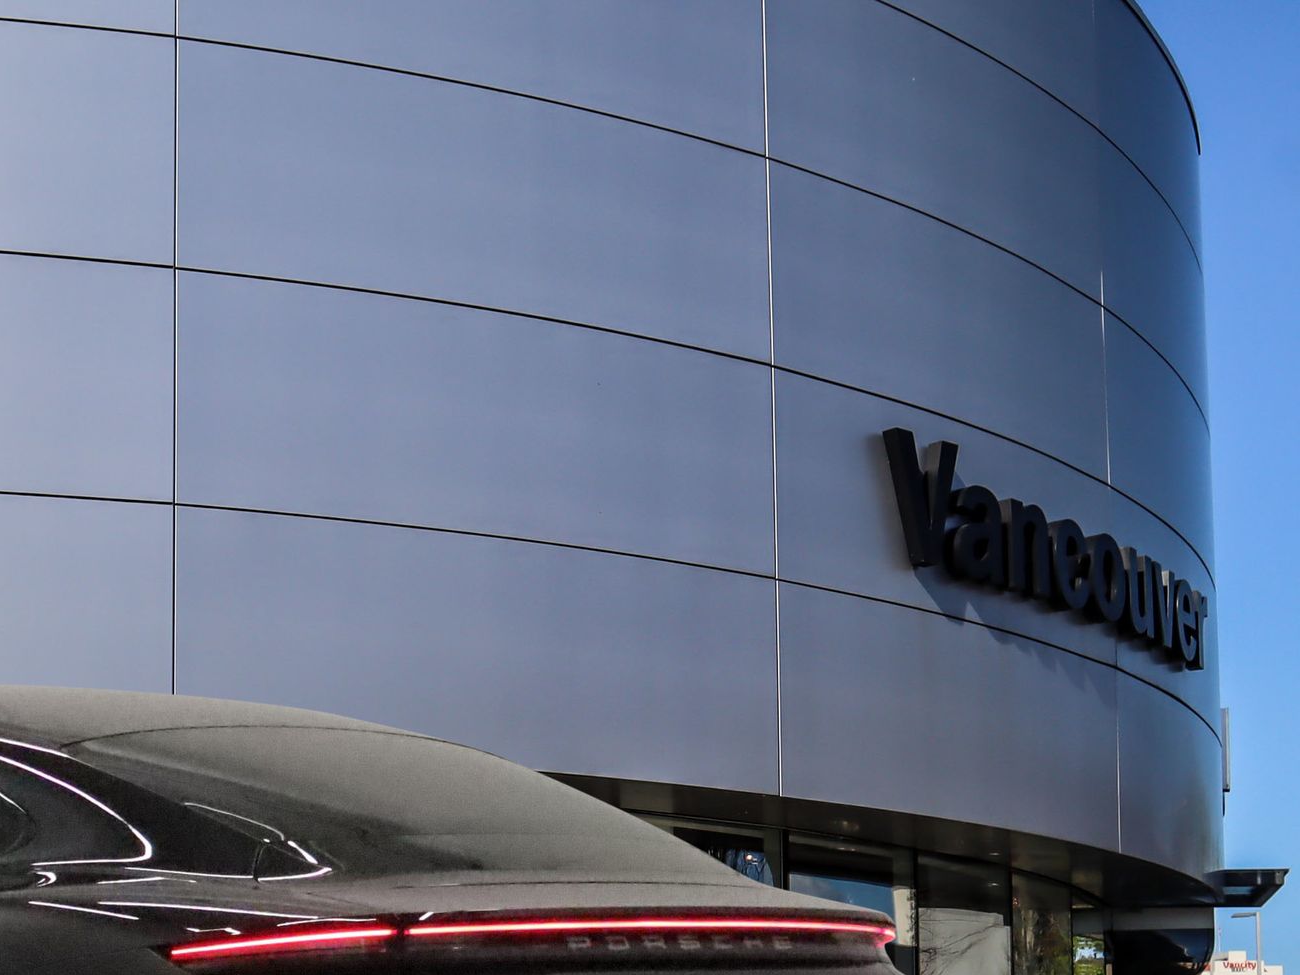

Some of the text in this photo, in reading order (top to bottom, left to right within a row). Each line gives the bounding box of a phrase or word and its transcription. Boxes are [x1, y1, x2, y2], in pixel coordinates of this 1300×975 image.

[883, 427, 1208, 671] Vancouver
[566, 934, 793, 951] PORSCHE
[1222, 961, 1257, 971] Vancity
